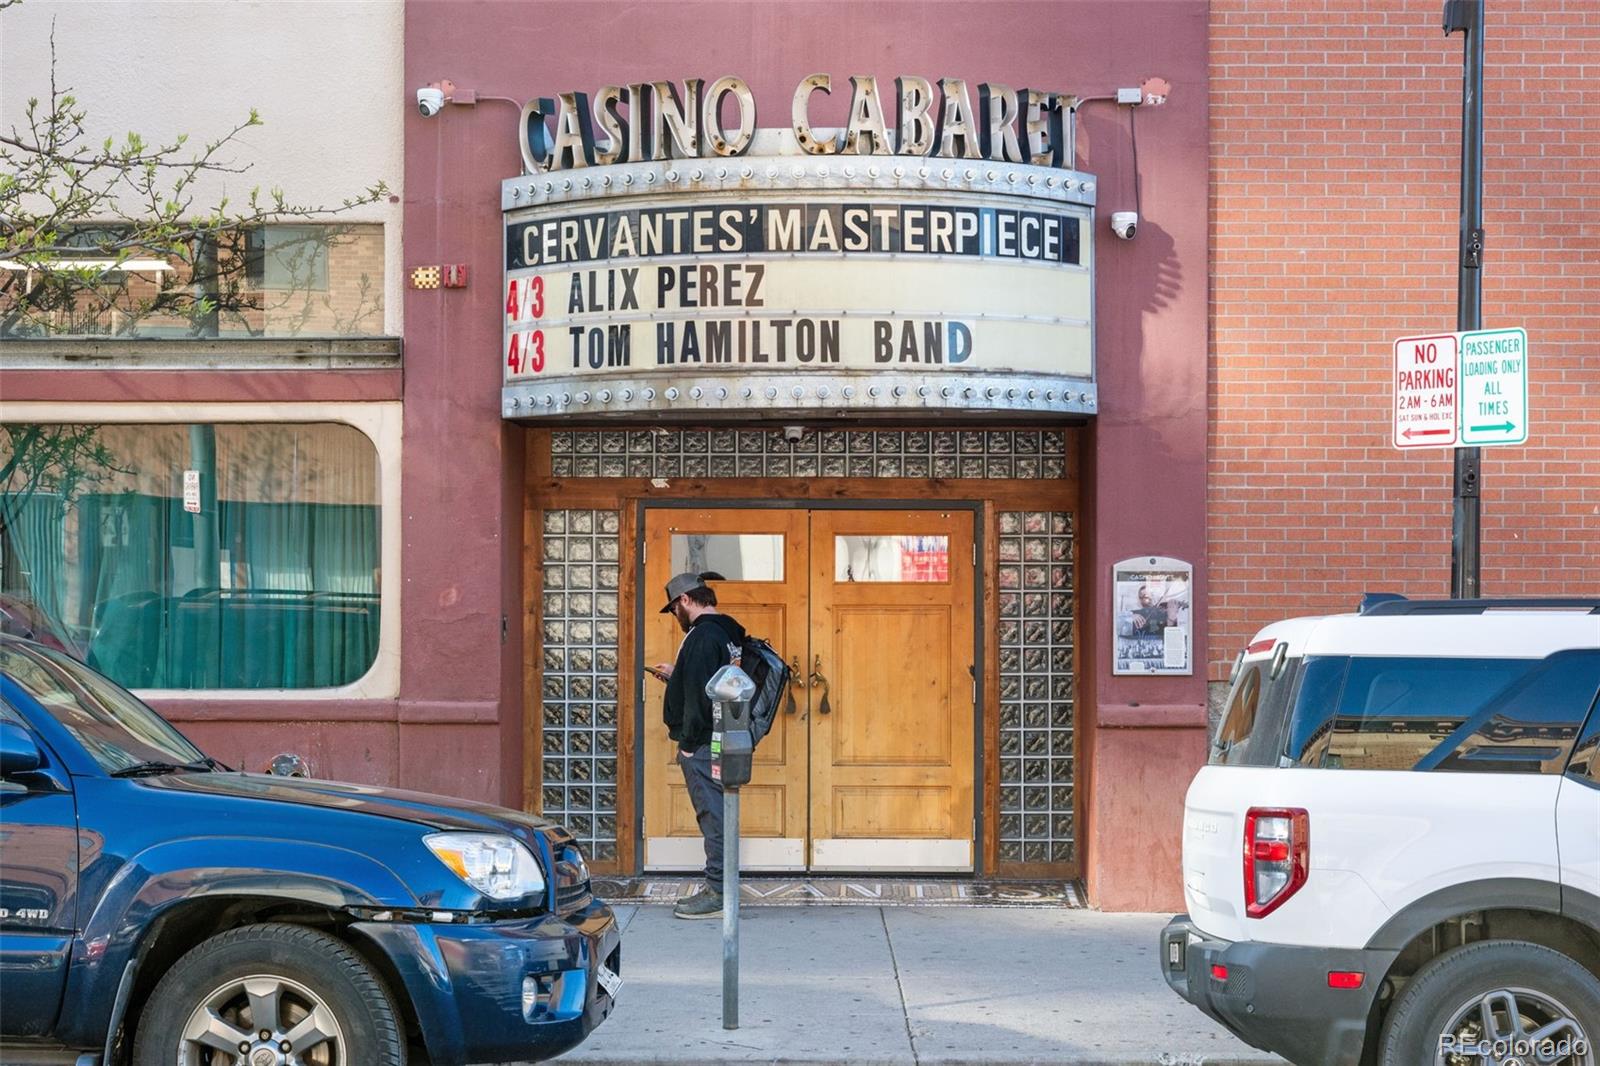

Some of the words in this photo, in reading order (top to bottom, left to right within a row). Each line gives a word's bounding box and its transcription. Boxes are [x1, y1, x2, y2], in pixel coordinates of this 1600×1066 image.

[519, 75, 756, 175] CASINO
[792, 73, 1078, 169] CABARET
[523, 209, 758, 266] CERVANTES'
[767, 208, 1059, 260] MASTERPIECE
[506, 275, 545, 321] 4/3
[568, 267, 640, 314] ALIX
[657, 263, 765, 309] PEREZ
[507, 329, 545, 375] 4/3
[569, 323, 631, 369] TOM
[656, 318, 840, 364] HAMILTON
[874, 320, 973, 364] BAND
[1414, 343, 1437, 364] NO
[1465, 338, 1520, 356] PASSENGER
[1465, 361, 1498, 376] LOADING
[1501, 359, 1521, 374] ONLY
[1399, 368, 1454, 391] PARKING
[1484, 381, 1502, 396] ALL
[1398, 413, 1409, 422] SAT
[1411, 413, 1423, 421] SUN
[1429, 412, 1441, 421] HOL
[1478, 400, 1509, 416] TIMES
[15, 908, 49, 919] 4WD
